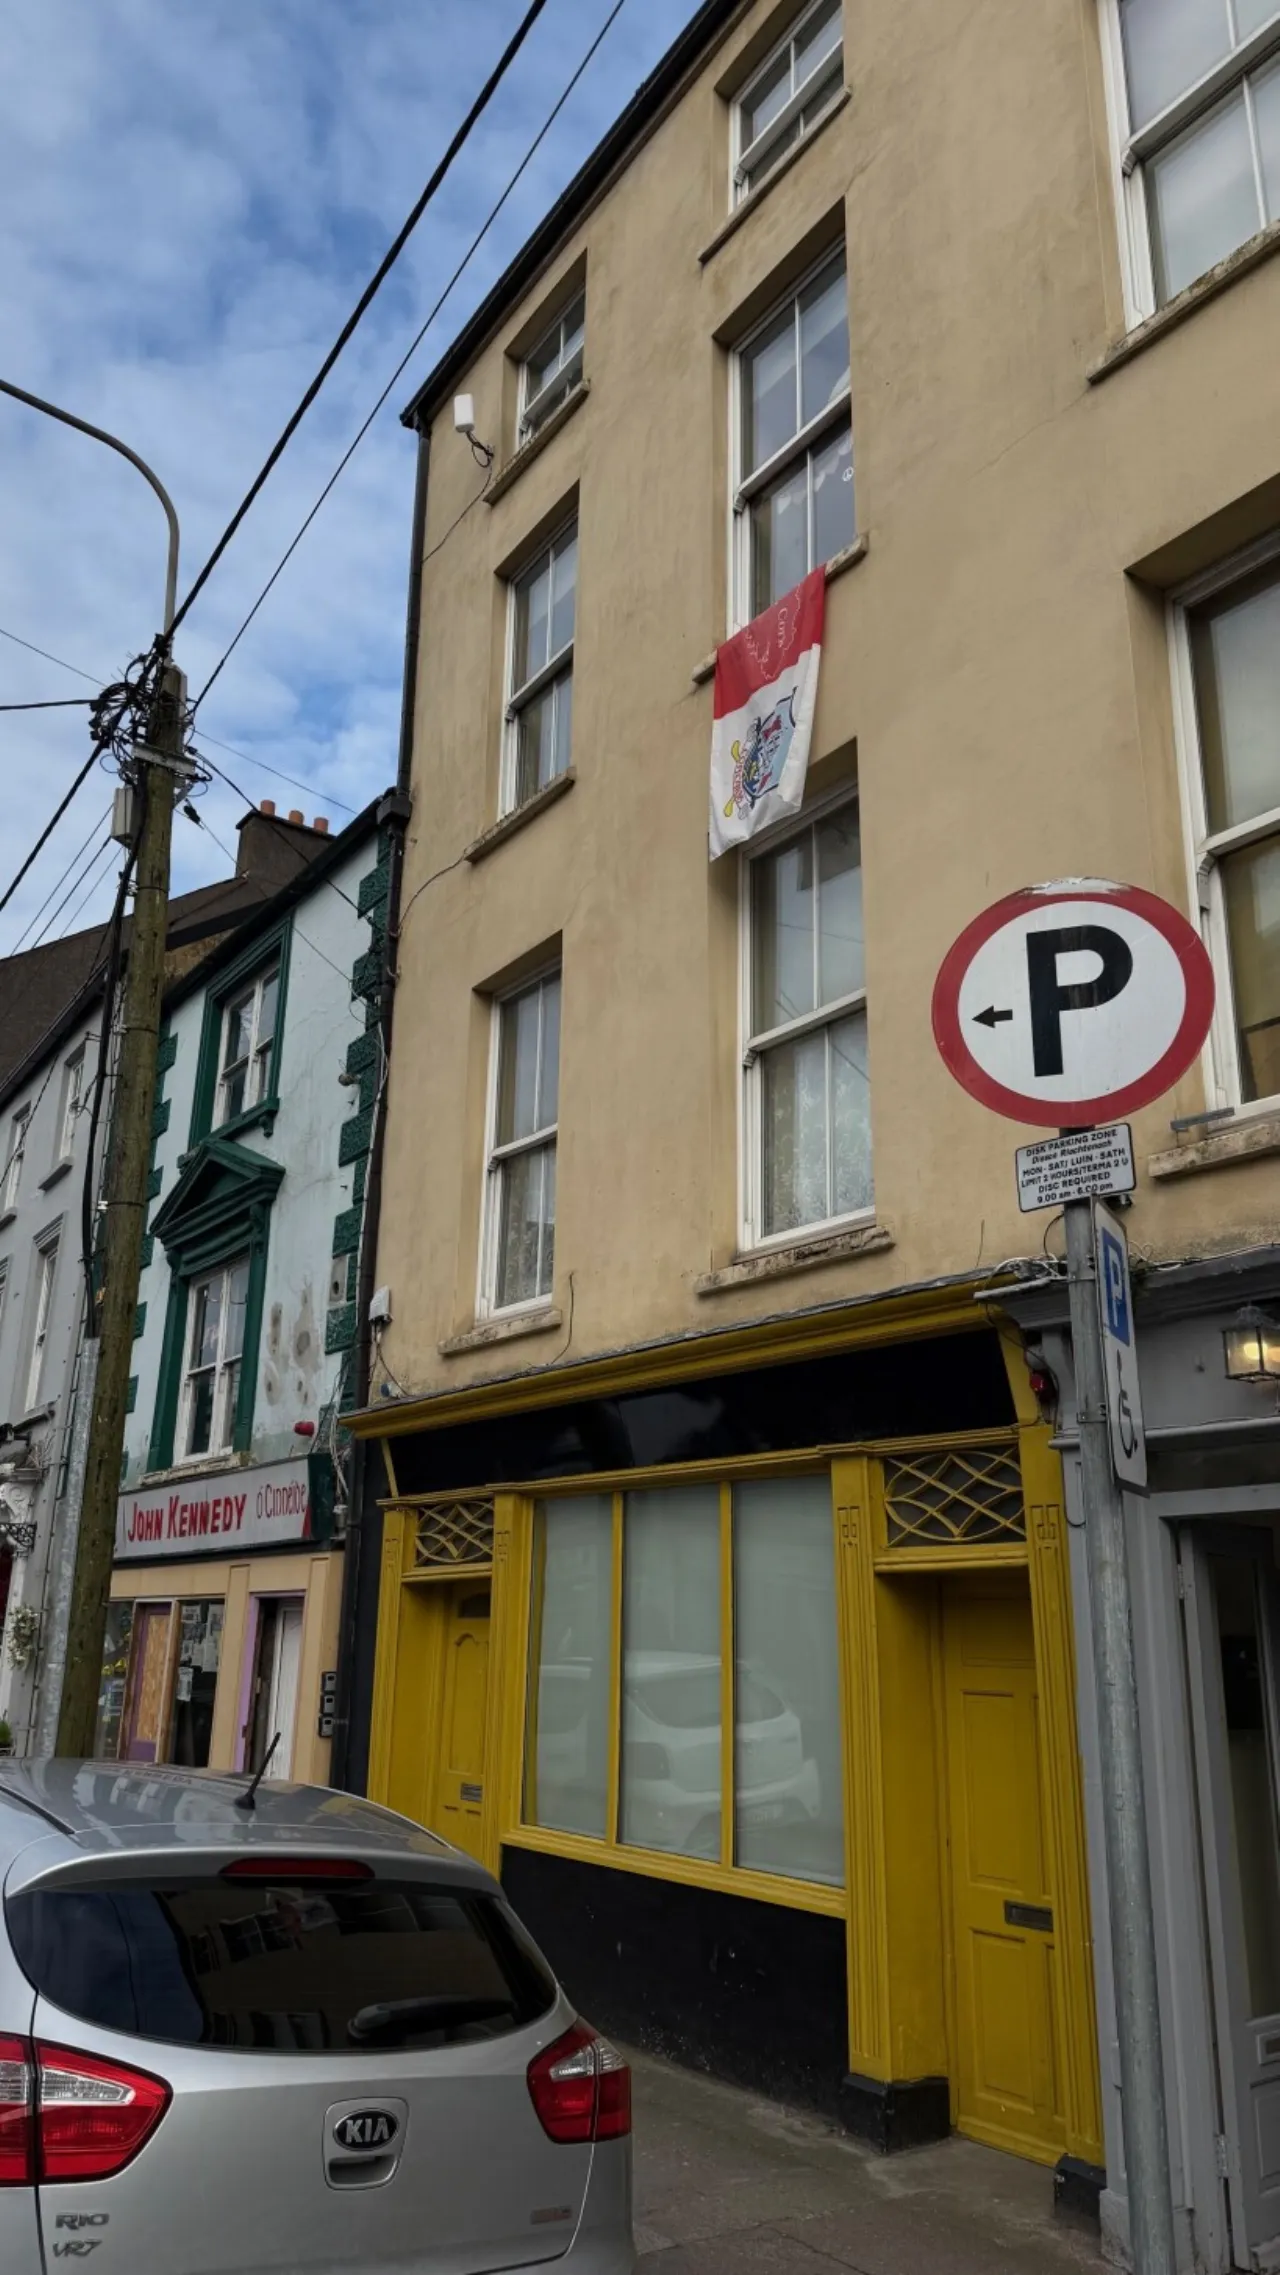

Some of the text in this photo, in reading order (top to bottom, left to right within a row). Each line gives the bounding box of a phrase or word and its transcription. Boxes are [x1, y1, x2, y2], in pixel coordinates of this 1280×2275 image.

[1026, 925, 1133, 1077] P
[1026, 1129, 1117, 1156] DISK PARKING ZONE
[1022, 1166, 1042, 1176] MON
[1071, 1154, 1092, 1165] LUIN
[1099, 1147, 1125, 1159] SATH
[1021, 1177, 1041, 1187] LIMIT
[1038, 1171, 1110, 1192] DISC REQUIRED
[1108, 1244, 1122, 1327] P
[128, 1502, 163, 1542] JOHN
[167, 1494, 247, 1539] KENNEDY
[345, 2116, 389, 2144] KIA
[56, 2213, 110, 2230] RIO
[53, 2240, 103, 2257] VR7
